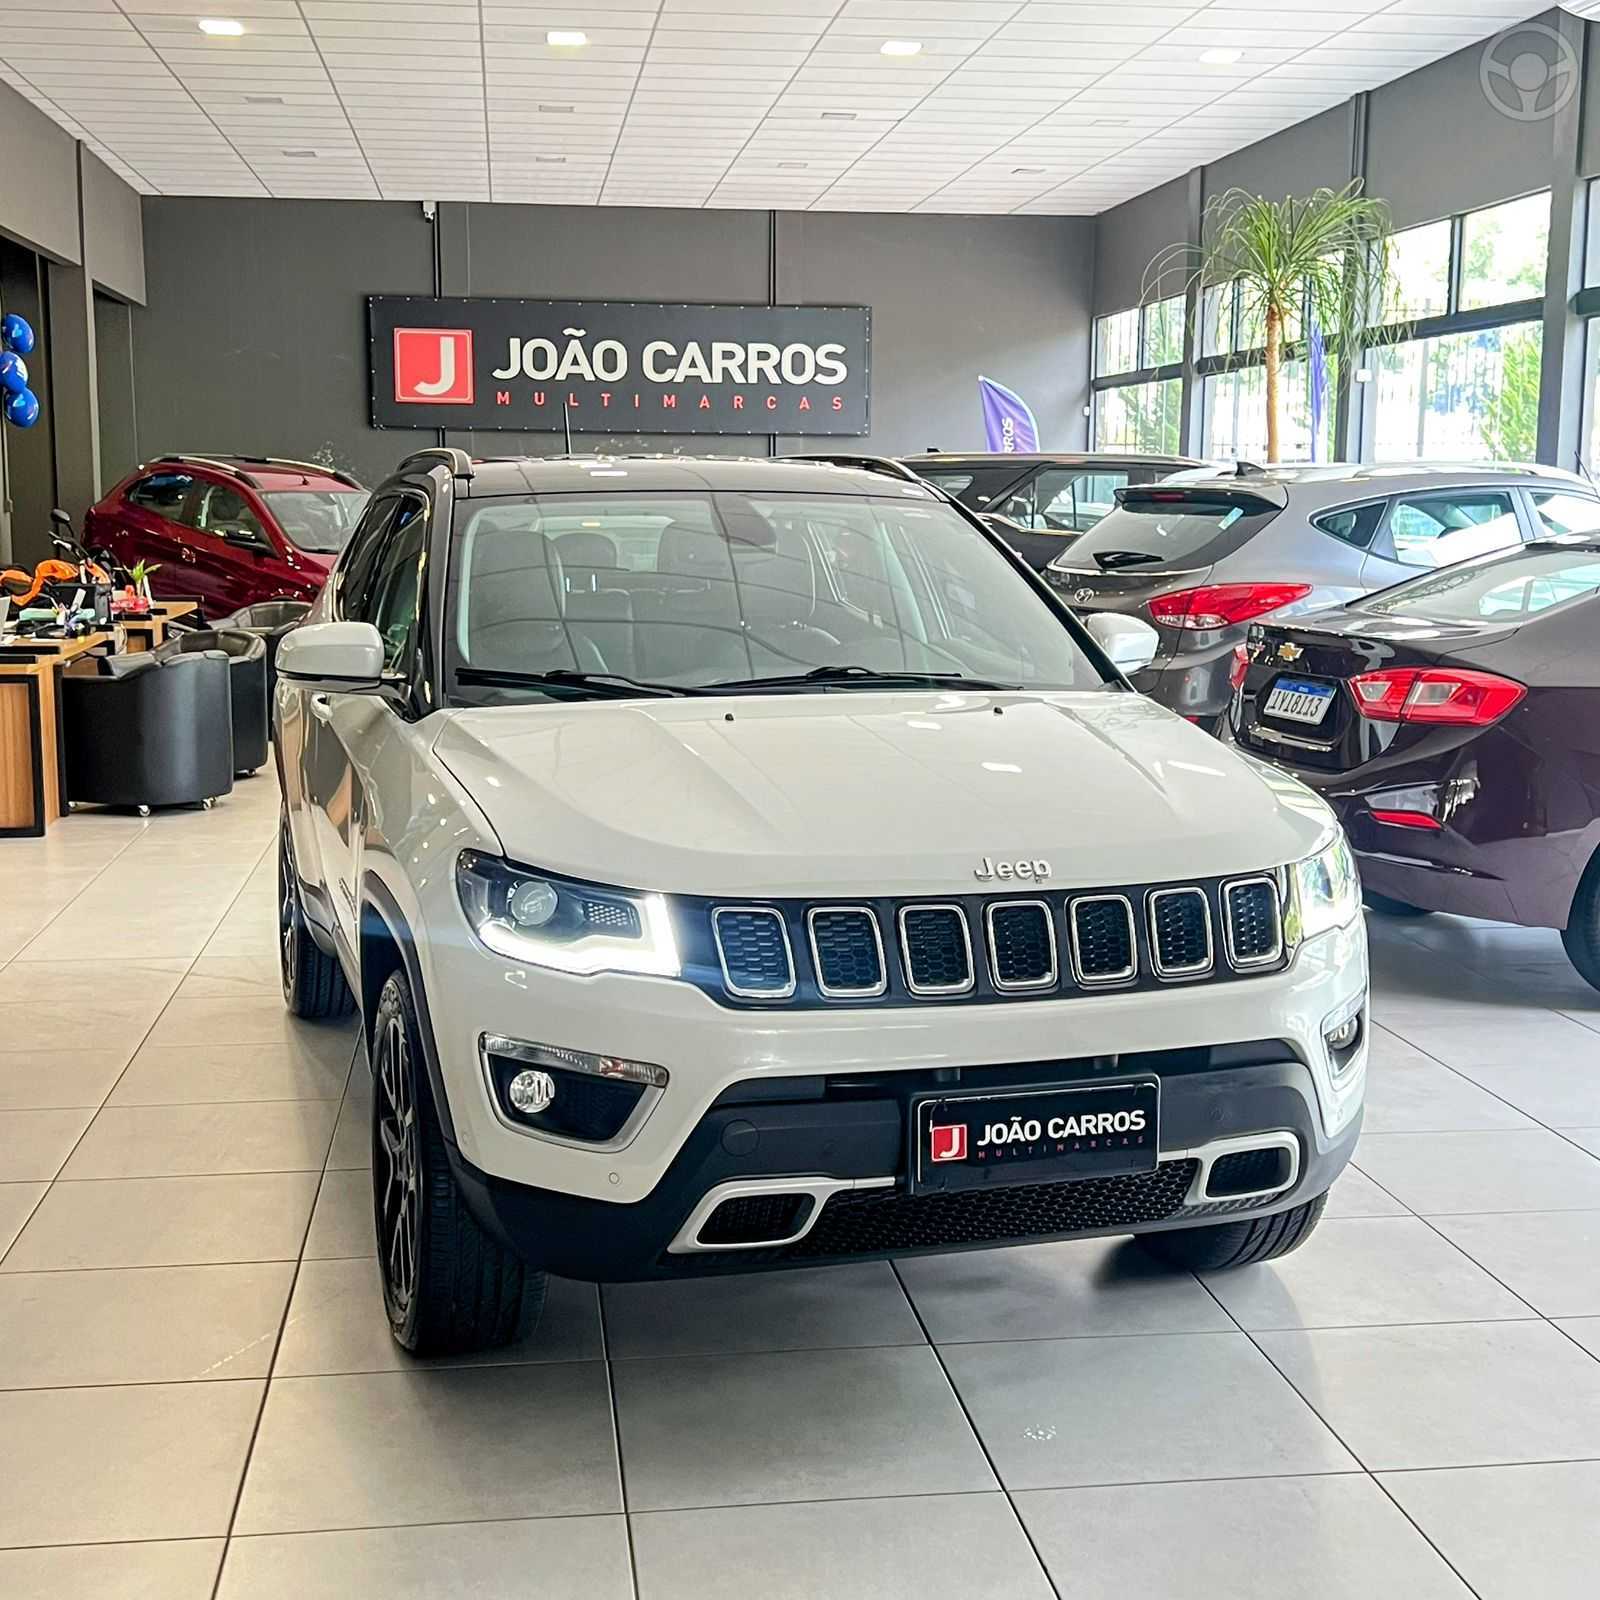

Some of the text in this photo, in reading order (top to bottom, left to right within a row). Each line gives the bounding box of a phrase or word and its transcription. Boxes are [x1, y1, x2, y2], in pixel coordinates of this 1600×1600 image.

[413, 336, 456, 396] J
[491, 327, 848, 385] JOÃO CARROS
[496, 391, 844, 411] MULTIMARCAS
[974, 857, 1052, 884] Jeep
[939, 1127, 960, 1158] J
[976, 1109, 1146, 1146] JOÃO CARROS
